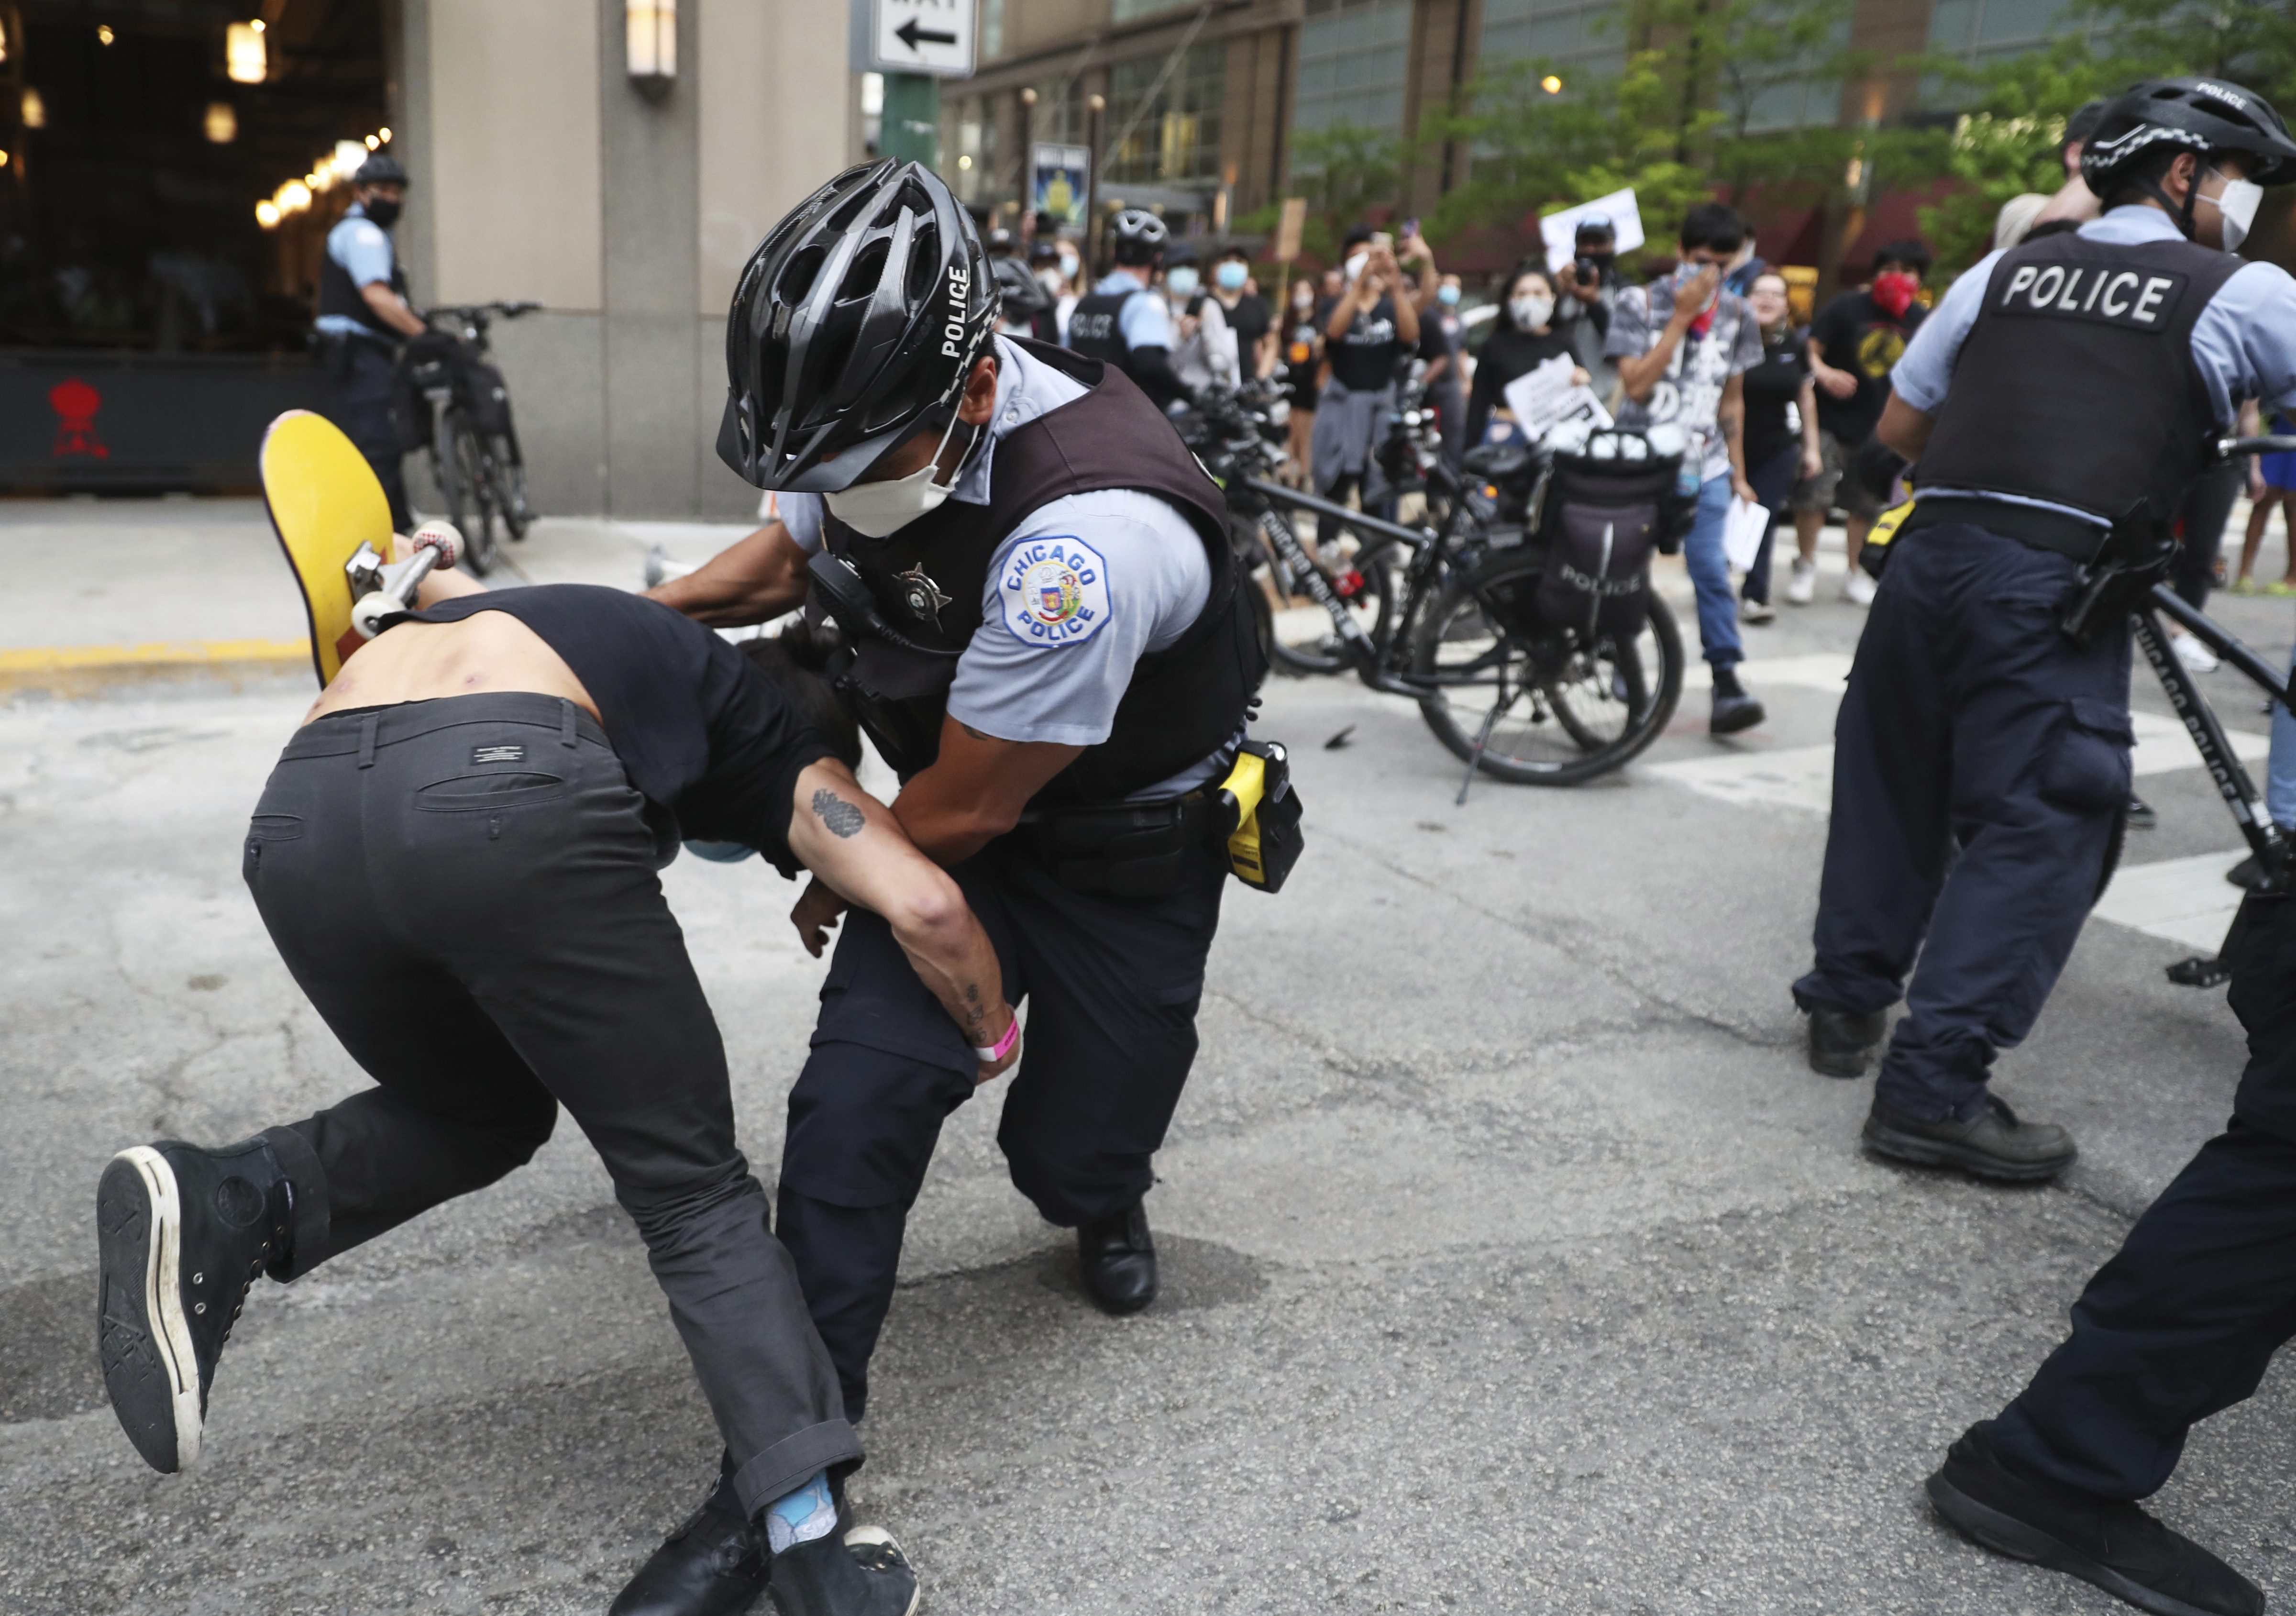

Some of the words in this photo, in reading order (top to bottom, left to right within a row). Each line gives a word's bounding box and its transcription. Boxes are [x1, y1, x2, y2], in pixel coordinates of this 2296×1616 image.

[2197, 82, 2247, 111] POLICE
[941, 266, 968, 358] POLICE
[2002, 266, 2173, 323] POLICE
[1007, 545, 1096, 591] CHICAGO
[1560, 563, 1641, 597] POLICE
[1305, 571, 1347, 622] POLICE
[1017, 606, 1095, 641] POLICE
[2184, 716, 2237, 797] POLICE
